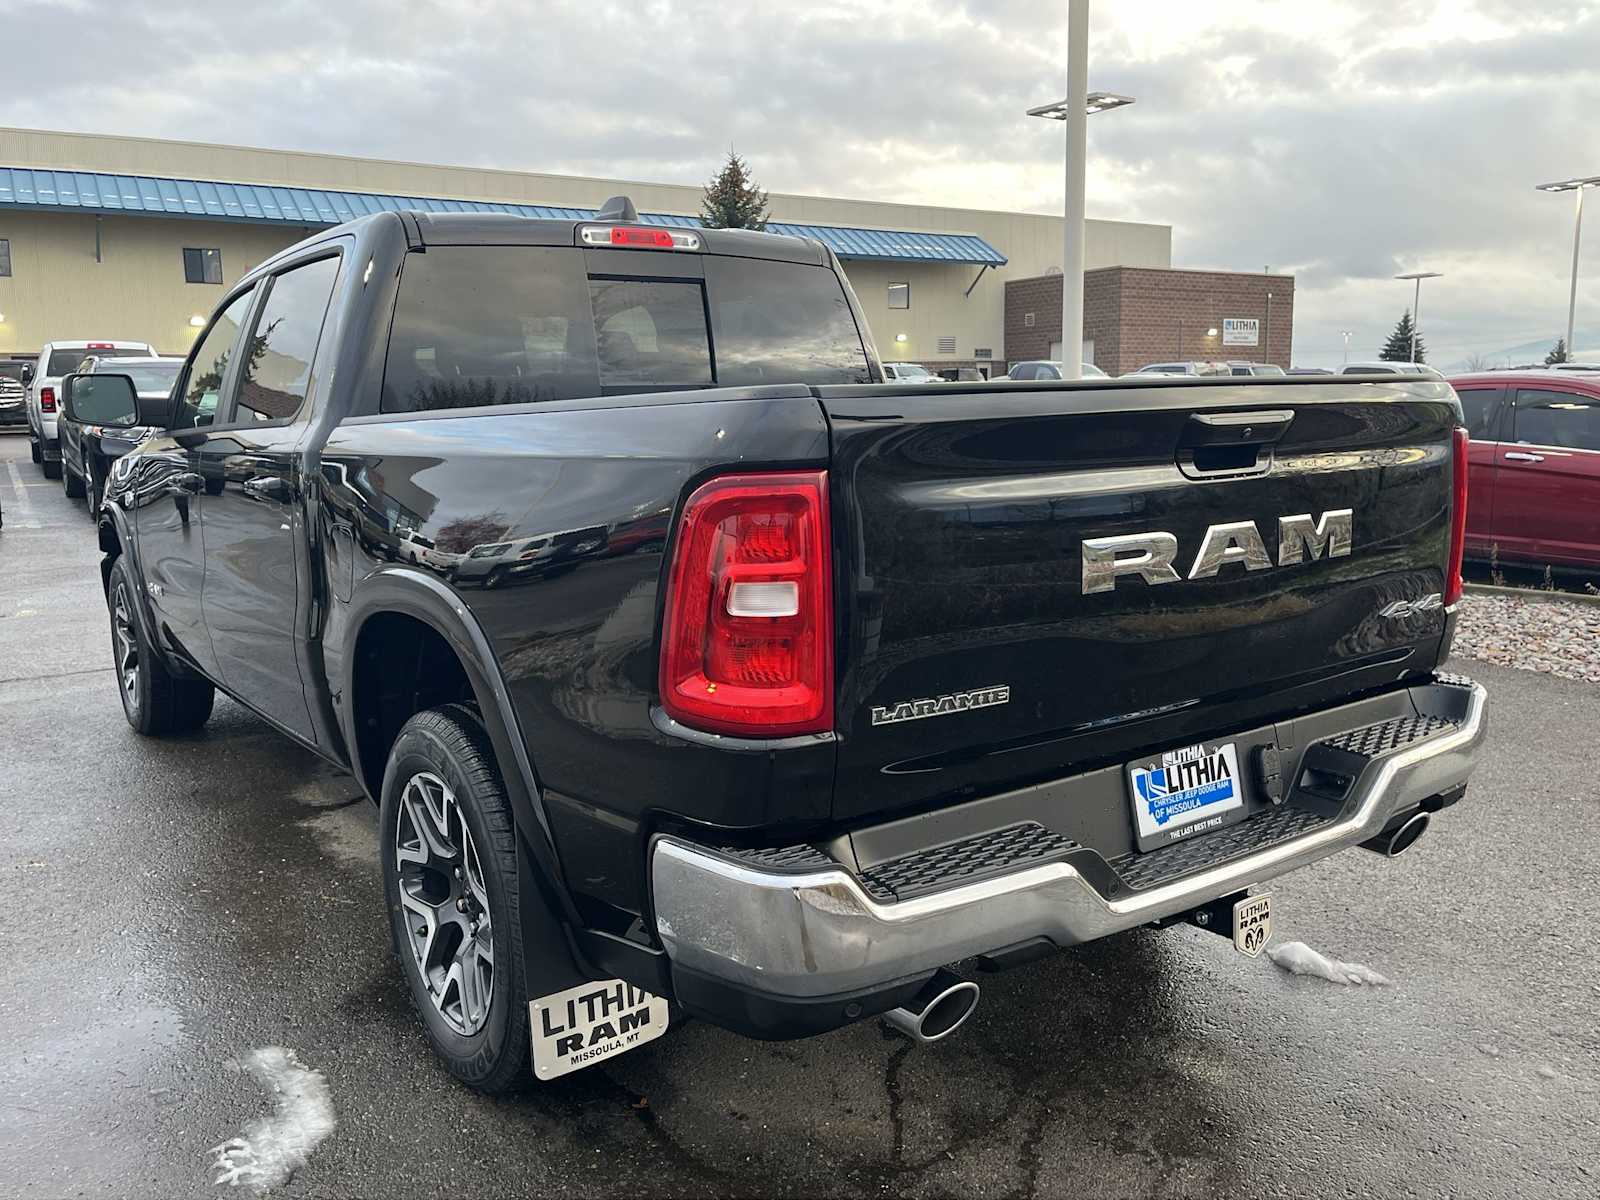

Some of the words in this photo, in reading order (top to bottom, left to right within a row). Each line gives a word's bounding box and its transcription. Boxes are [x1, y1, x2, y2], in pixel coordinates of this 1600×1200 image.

[1232, 320, 1257, 331] LITHIA
[1082, 508, 1353, 595] RAM
[871, 686, 1010, 726] LARAMIE
[1172, 744, 1205, 764] LITHIA
[1165, 753, 1231, 794] LITHIA
[1154, 792, 1184, 808] CHRYSLER
[1184, 788, 1198, 800] JEEP
[1198, 785, 1217, 797] DODGE
[1216, 780, 1230, 790] RAM
[1155, 808, 1166, 819] OF
[1166, 797, 1202, 816] MISSOULA
[1169, 830, 1181, 840] THE
[1181, 825, 1194, 836] LAST
[1194, 821, 1208, 832] BEST
[1207, 816, 1222, 828] PRICE
[1240, 901, 1269, 920] LITHIA
[1240, 911, 1269, 929] RAM
[556, 1006, 651, 1057] RAM
[570, 1040, 624, 1065] MISSOULA,
[626, 1031, 640, 1043] MT
